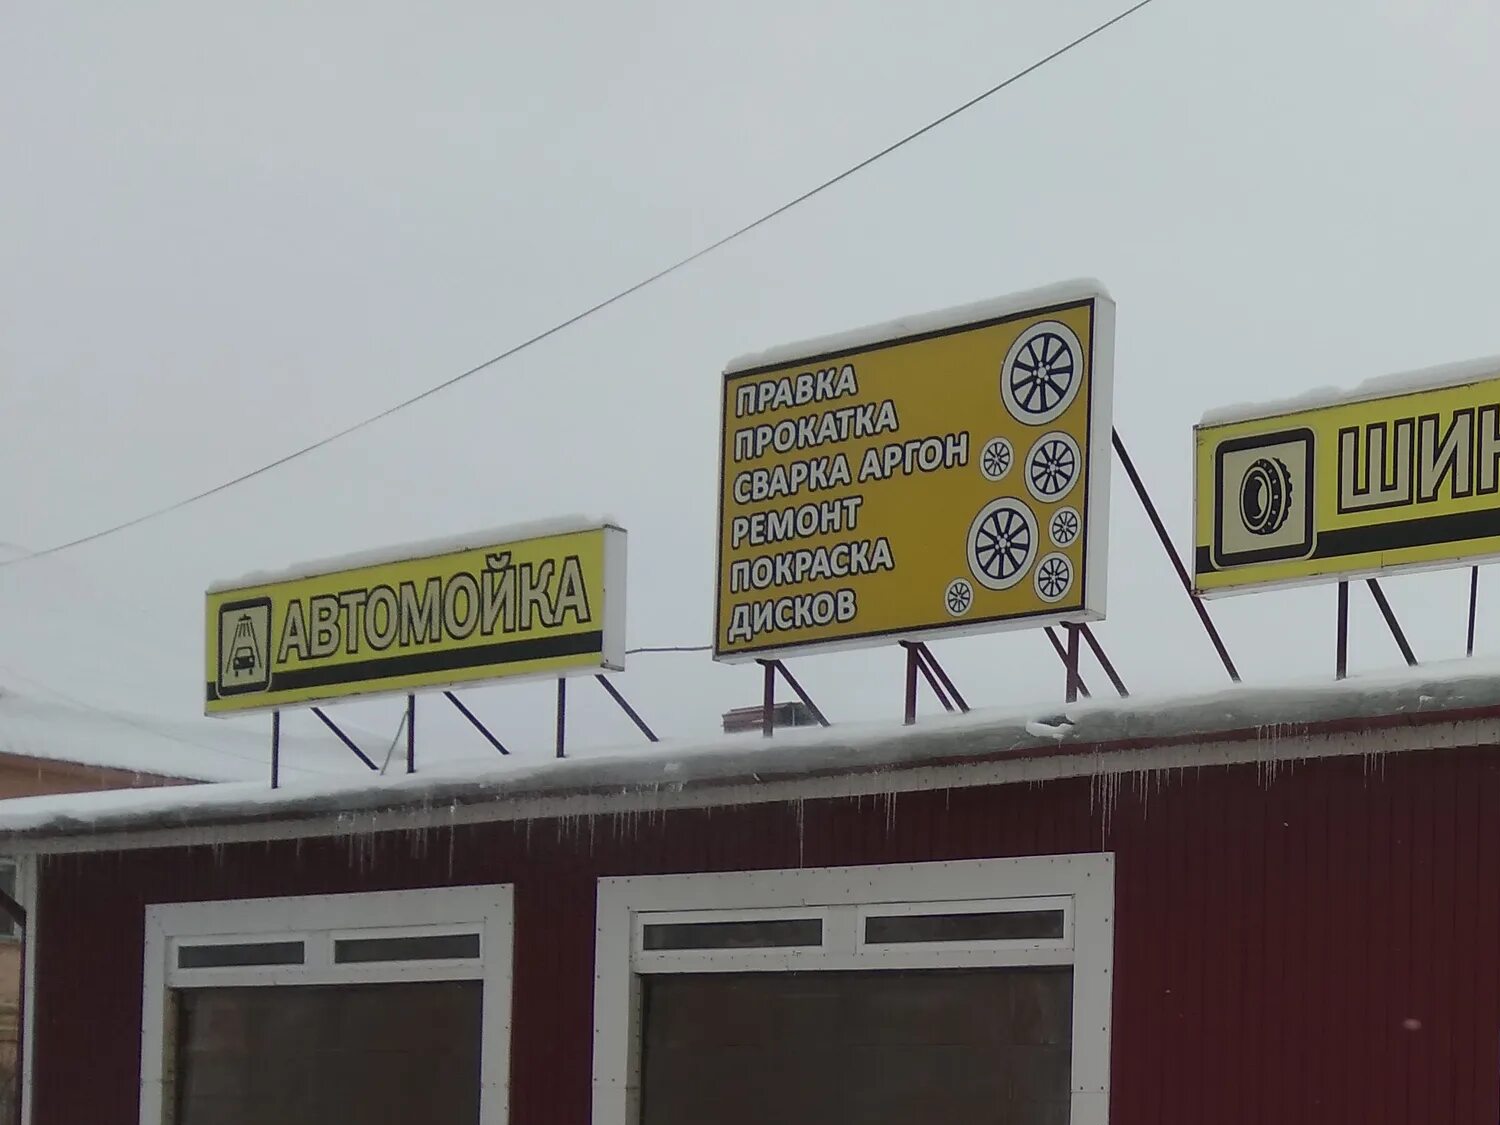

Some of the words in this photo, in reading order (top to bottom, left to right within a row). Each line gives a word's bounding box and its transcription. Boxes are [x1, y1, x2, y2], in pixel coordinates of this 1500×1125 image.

[735, 364, 858, 417] ПРАВКА
[734, 399, 899, 462] ПРОКАТКА
[733, 453, 851, 505] СВАРКА
[858, 431, 970, 482] АРГОН
[731, 496, 863, 549] РЕМОНТ
[730, 538, 895, 593] ПОКРАСКА
[276, 551, 591, 664] АВТОМОЙКА
[727, 588, 858, 644] ДИСКОВ
